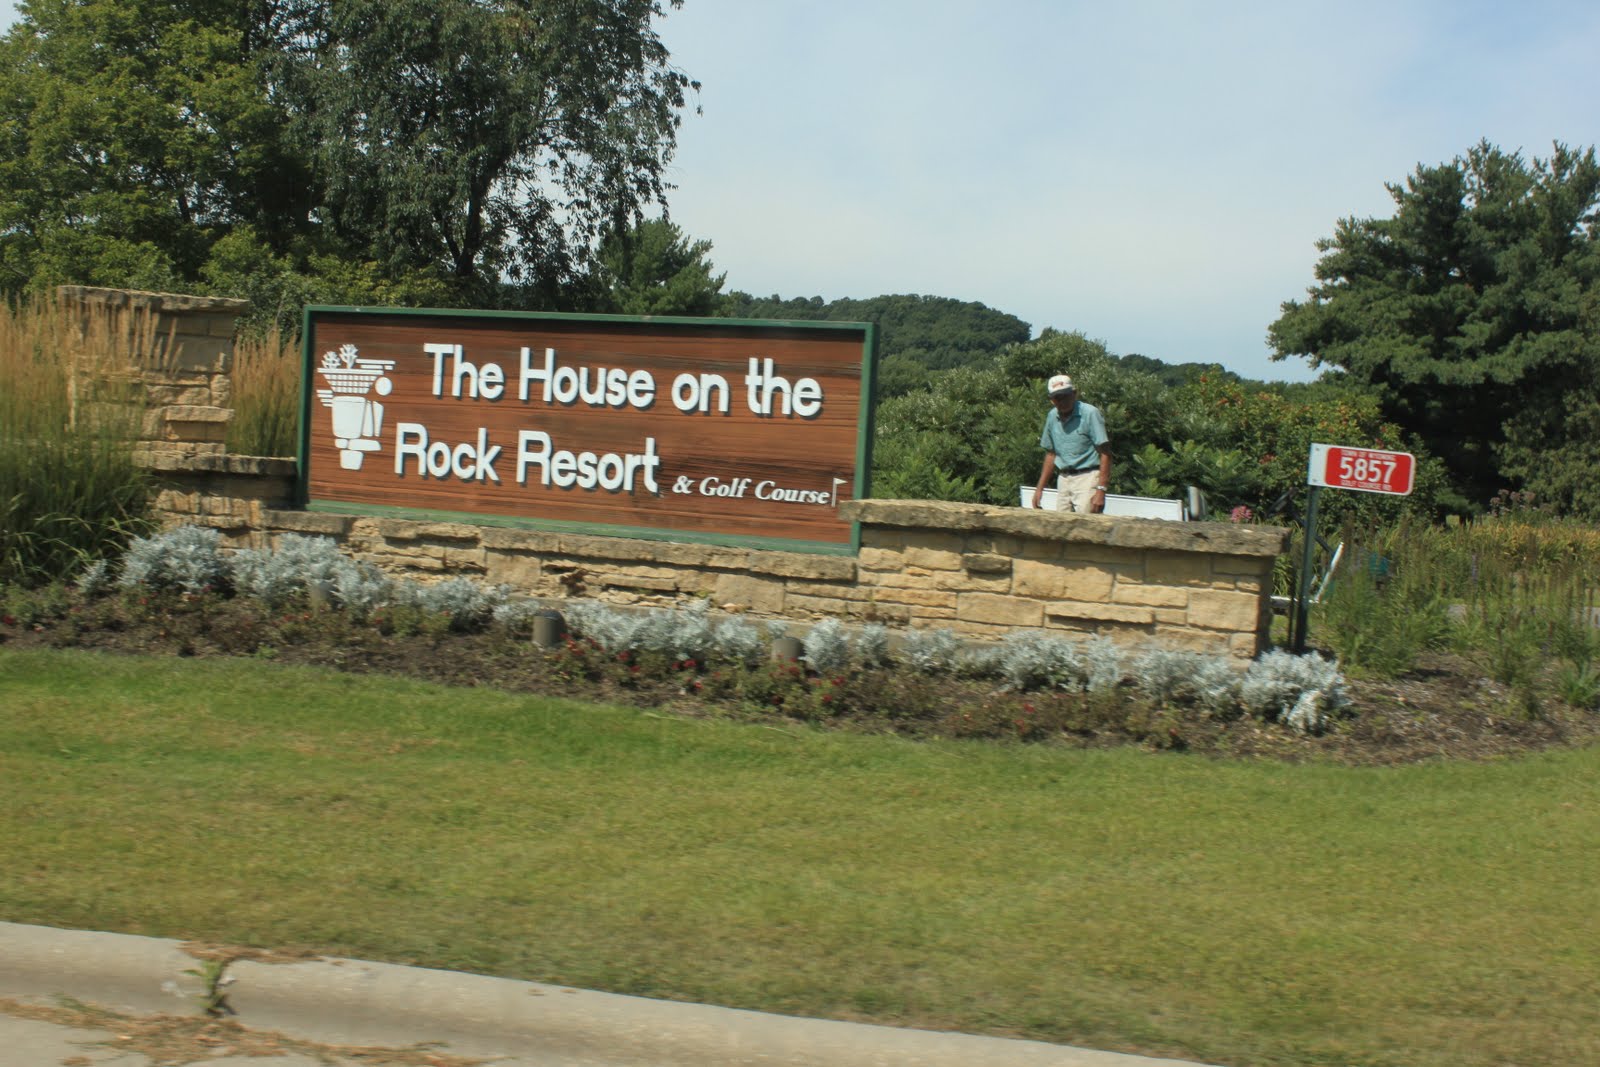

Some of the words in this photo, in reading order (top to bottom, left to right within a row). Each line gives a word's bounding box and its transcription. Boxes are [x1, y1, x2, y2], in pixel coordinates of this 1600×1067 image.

[424, 343, 504, 399] The
[518, 346, 655, 408] House
[671, 372, 730, 412] on
[745, 357, 823, 417] the
[394, 422, 501, 481] Rock
[516, 430, 660, 493] Resort
[1339, 457, 1397, 483] 5857
[672, 475, 696, 495] &
[699, 476, 752, 498] Golf
[754, 480, 831, 505] Course
